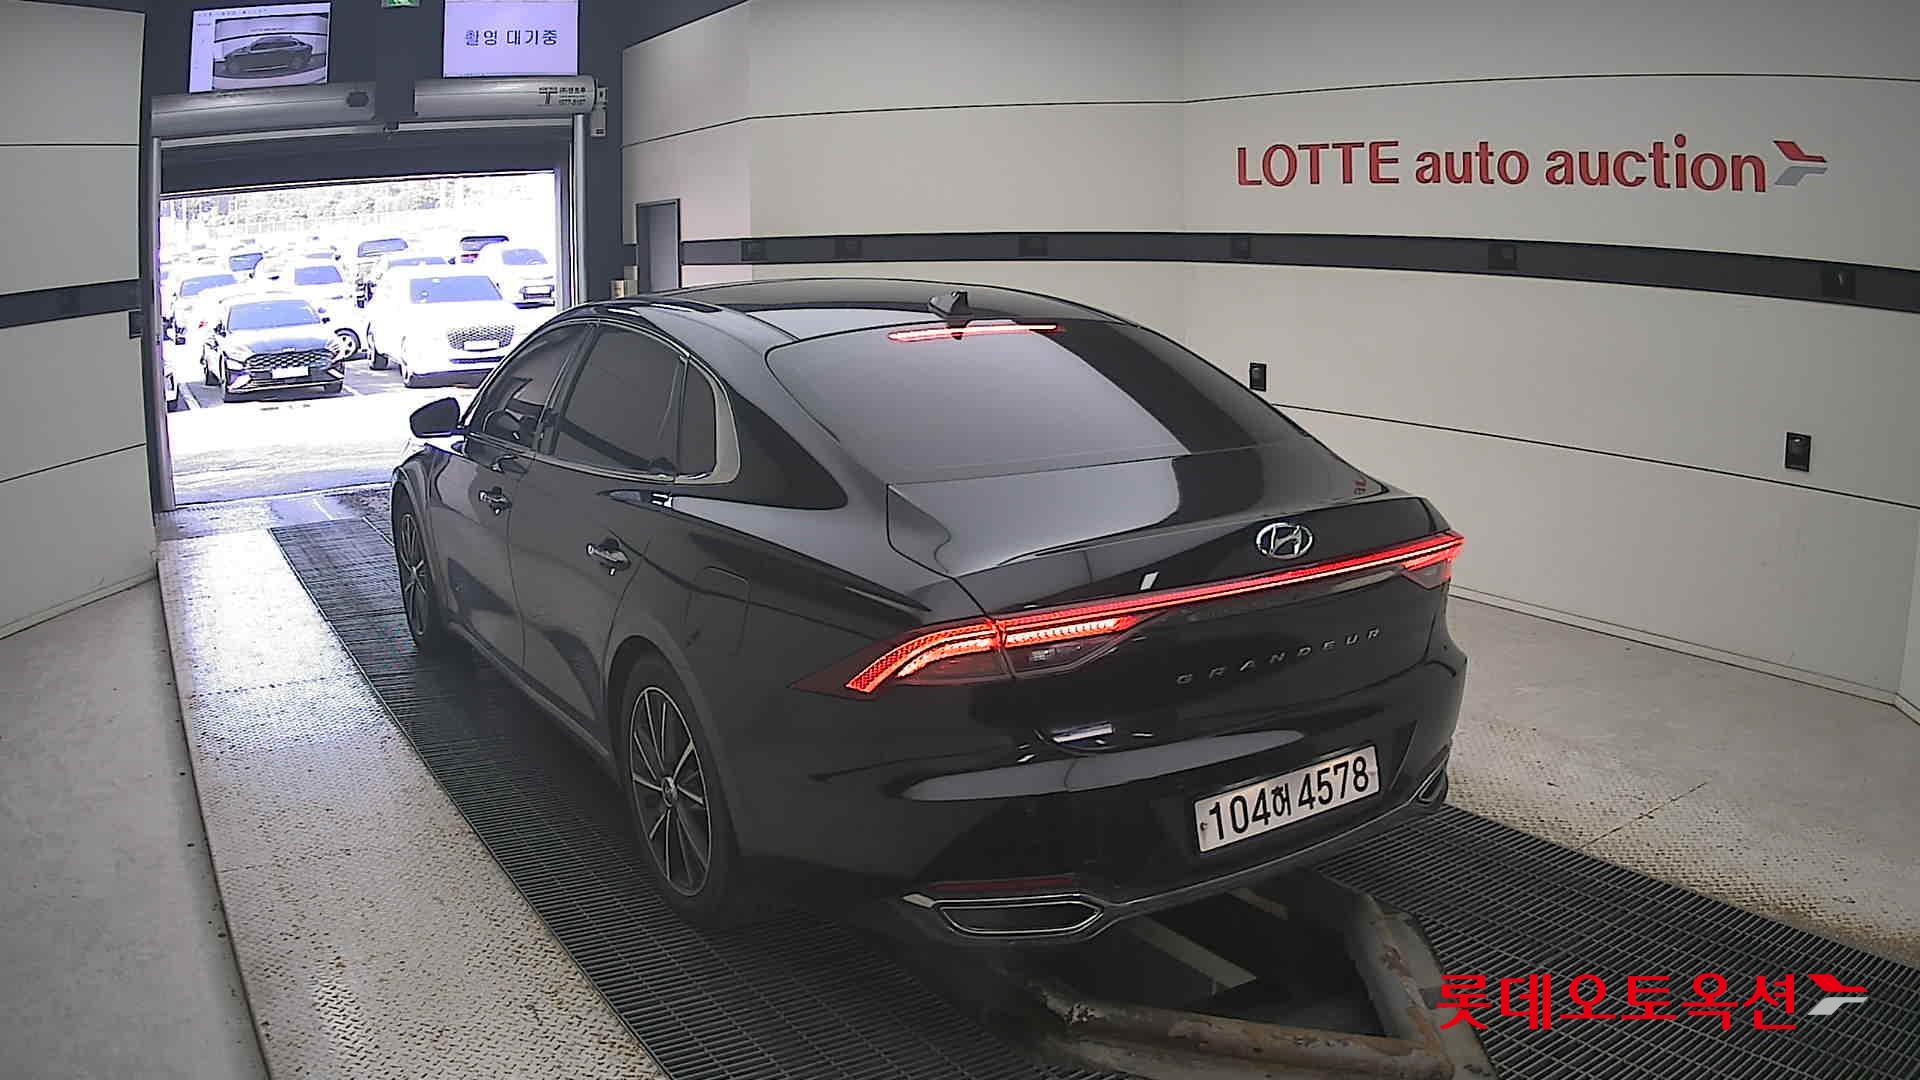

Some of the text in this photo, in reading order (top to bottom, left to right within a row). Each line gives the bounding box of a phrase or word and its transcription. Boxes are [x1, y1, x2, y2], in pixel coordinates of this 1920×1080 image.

[506, 29, 557, 46] 대기중
[1236, 134, 1766, 193] LOTTE auto auction
[1176, 627, 1380, 685] GRANDEUR
[1209, 756, 1369, 840] 104허 4578
